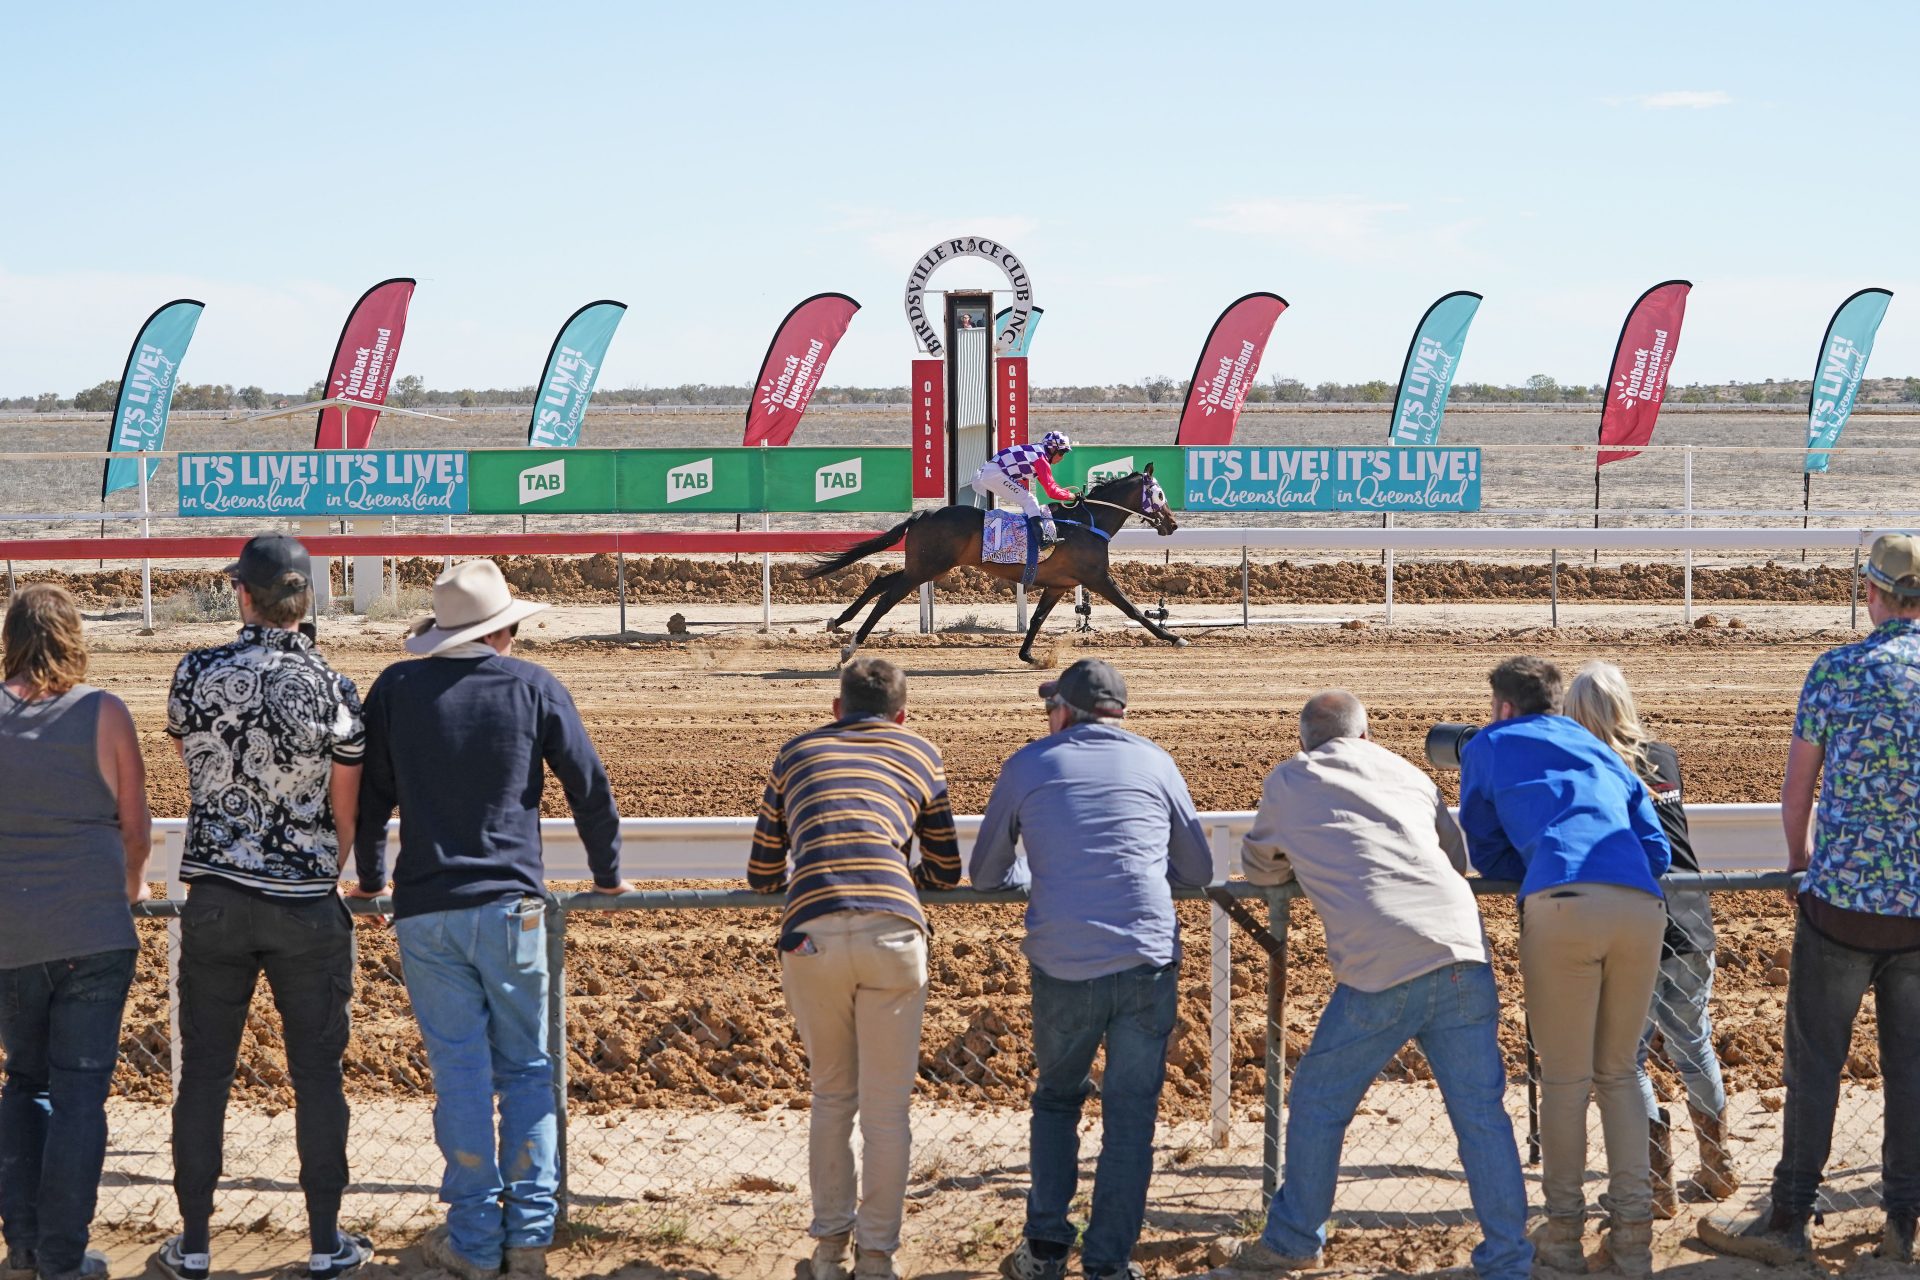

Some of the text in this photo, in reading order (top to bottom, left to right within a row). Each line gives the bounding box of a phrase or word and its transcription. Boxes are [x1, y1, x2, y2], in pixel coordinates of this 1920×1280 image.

[908, 239, 1029, 352] BIRDSVILLE RACE CLUB INC.
[345, 347, 370, 396] Outback
[360, 328, 391, 400] Queensland
[771, 355, 800, 404] Outback
[783, 338, 823, 409] Queensland
[1207, 356, 1233, 405] Outback
[1220, 340, 1255, 410] Queensland
[1626, 348, 1649, 397] Outback
[1639, 329, 1668, 400] Queensland
[1810, 335, 1854, 438] IT'S LIVE!
[119, 344, 163, 448] IT'S LIVE!
[140, 354, 176, 437] Queensland
[530, 346, 582, 447] IT'S LIVE!
[554, 359, 595, 441] Queensland
[1397, 337, 1442, 441] IT'S LIVE!
[1418, 349, 1455, 444] in Queensland
[924, 381, 932, 478] Outback
[1826, 430, 1838, 441] in
[182, 456, 318, 486] IT'S LIVE!
[326, 454, 464, 484] IT'S LIVE!
[524, 474, 560, 490] TAB
[672, 472, 708, 489] TAB
[820, 472, 857, 488] TAB
[1190, 450, 1329, 481] IT'S LIVE!
[1337, 450, 1477, 481] IT'S LIVE!
[182, 477, 310, 512] in Queensland
[327, 476, 455, 511] in Queensland
[1190, 474, 1321, 508] in Queensland
[1338, 474, 1469, 507] in Queensland
[990, 518, 1002, 550] 1
